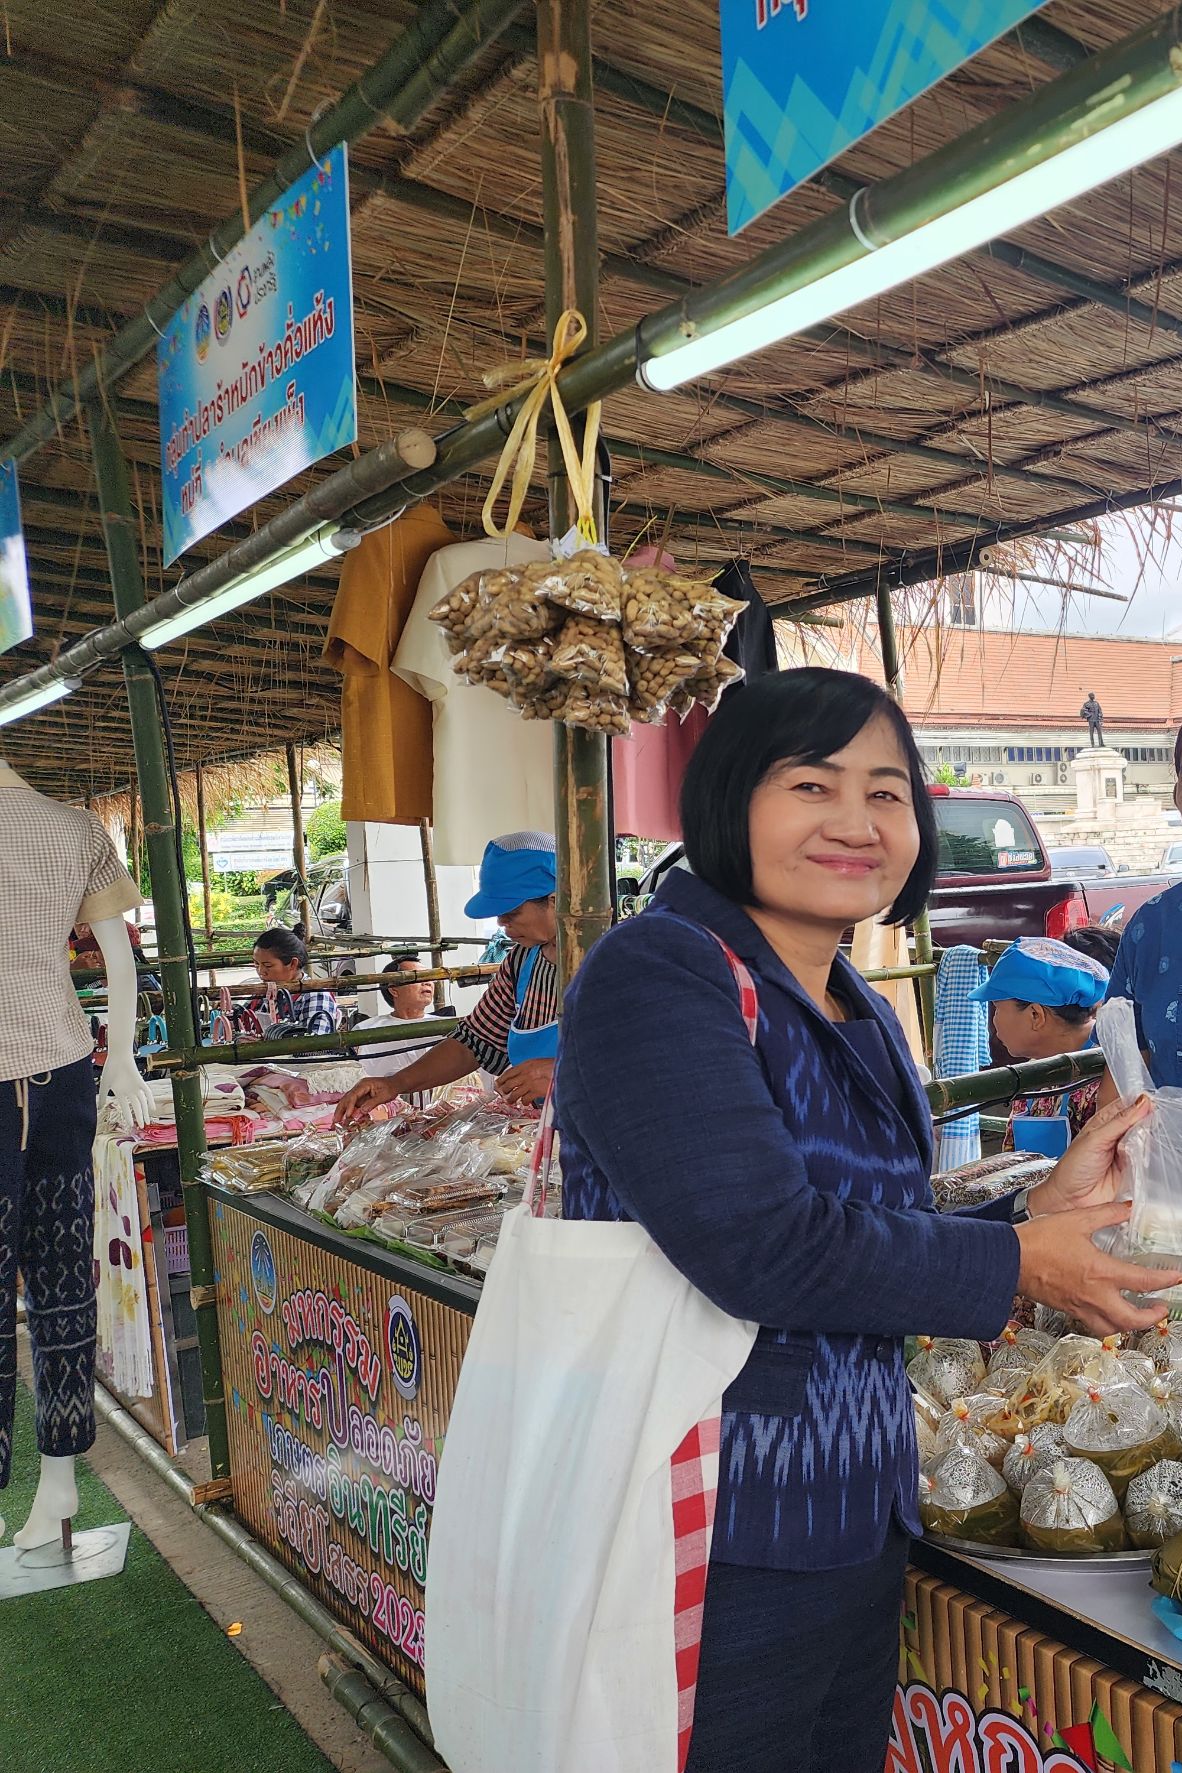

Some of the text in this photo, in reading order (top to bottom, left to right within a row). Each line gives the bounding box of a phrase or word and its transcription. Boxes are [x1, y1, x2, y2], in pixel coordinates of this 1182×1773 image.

[283, 1287, 381, 1401] มหกรรม
[252, 1330, 437, 1505] อาหารปลอดภัย
